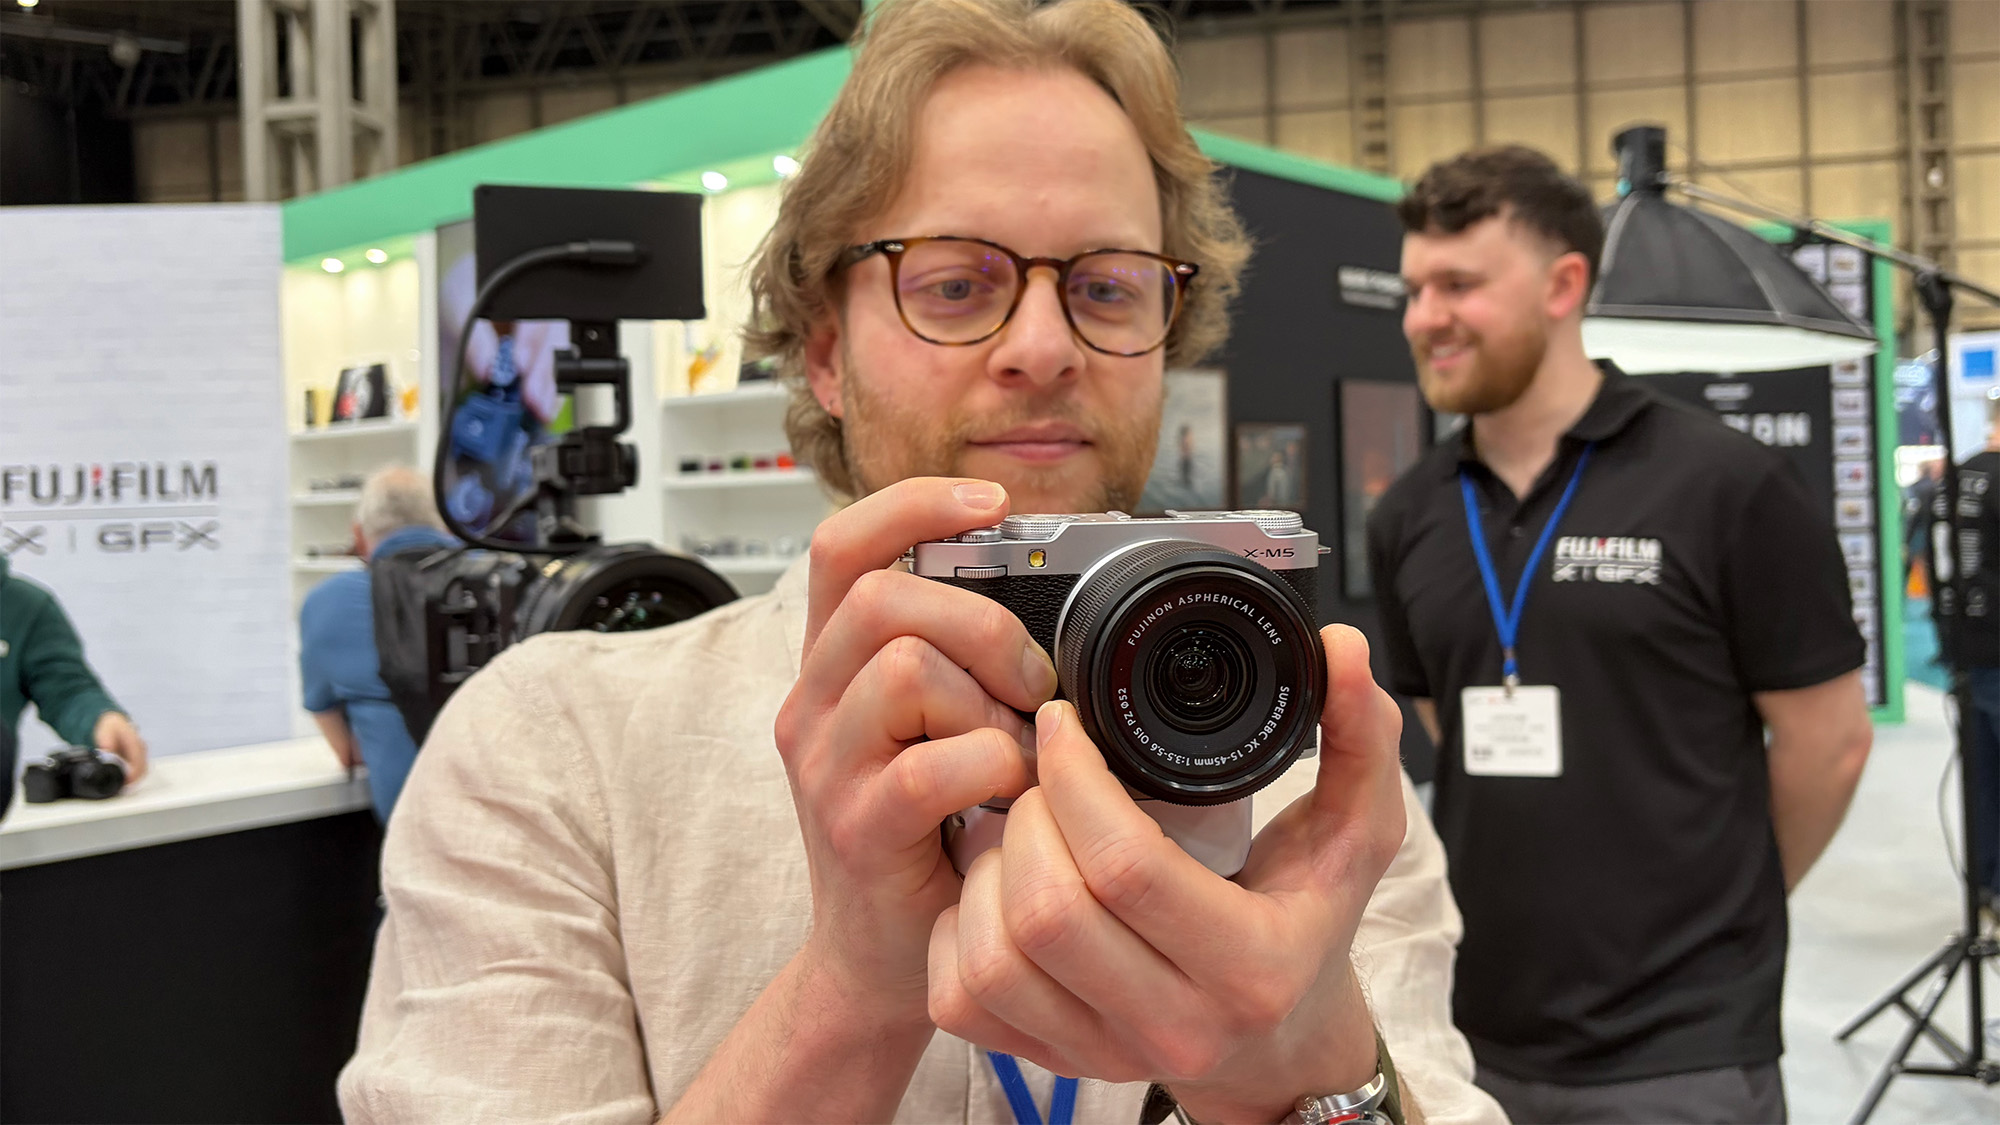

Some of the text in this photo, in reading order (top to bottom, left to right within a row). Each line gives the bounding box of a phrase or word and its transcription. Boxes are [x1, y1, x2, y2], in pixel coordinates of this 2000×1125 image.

[2, 460, 219, 506] FUJIFILM
[97, 519, 221, 554] GFX
[1243, 547, 1296, 559] X-M5
[1556, 536, 1662, 561] FUJIFILM
[1127, 592, 1282, 646] FUJINON ASPHERICAL LENS
[1271, 685, 1290, 721] SUPER
[1123, 710, 1137, 727] PZ
[1258, 719, 1278, 741] EBC
[1132, 726, 1150, 745] OIS
[1243, 738, 1261, 754] XC
[1149, 742, 1191, 767] 1:3.5-5.6
[1193, 749, 1244, 767] 15-45mm
